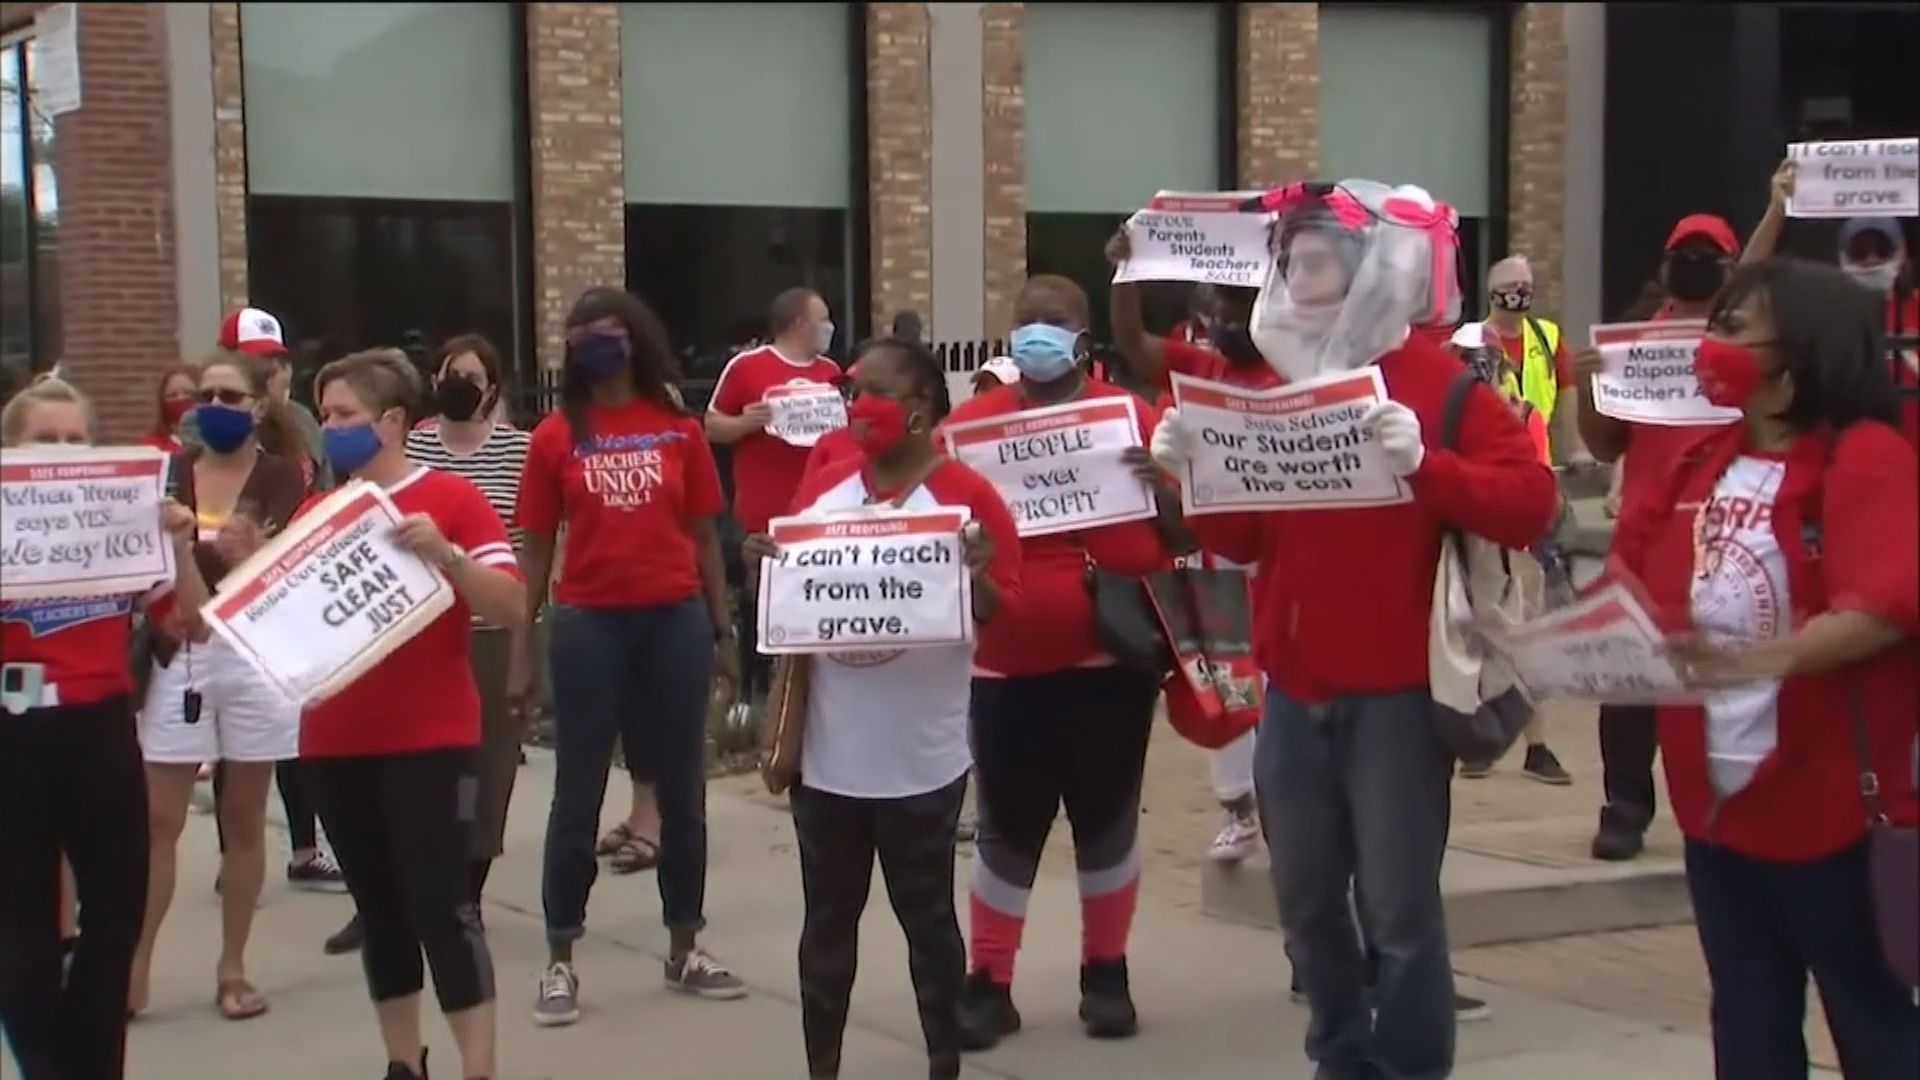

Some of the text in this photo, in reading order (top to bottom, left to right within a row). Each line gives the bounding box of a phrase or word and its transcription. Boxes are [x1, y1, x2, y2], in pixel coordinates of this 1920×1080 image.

[1824, 162, 1876, 180] from
[1147, 228, 1206, 243] Parents
[1169, 243, 1236, 258] Students
[1189, 258, 1260, 271] Teachers
[1627, 346, 1687, 362] Masks
[1602, 383, 1687, 401] Teachers
[997, 428, 1093, 465] PEOPLE
[1202, 426, 1375, 455] Our Students
[583, 449, 662, 470] TEACHERS
[1224, 452, 1362, 476] are worth
[583, 463, 663, 494] UNION
[1022, 466, 1080, 490] over
[1241, 476, 1286, 493] the
[1295, 476, 1353, 491] cost
[2, 486, 74, 506] When
[602, 492, 643, 508] LOCAL
[15, 517, 71, 536] says
[823, 522, 848, 537] SAFE
[48, 543, 98, 569] say
[104, 531, 155, 560] NO!
[796, 545, 863, 568] can't
[870, 541, 950, 565] teach
[287, 559, 317, 589] Our
[320, 541, 379, 593] SAFE
[322, 564, 399, 628] CLEAN
[803, 575, 924, 602] from the
[364, 585, 416, 635] JUST
[817, 615, 910, 641] grave.
